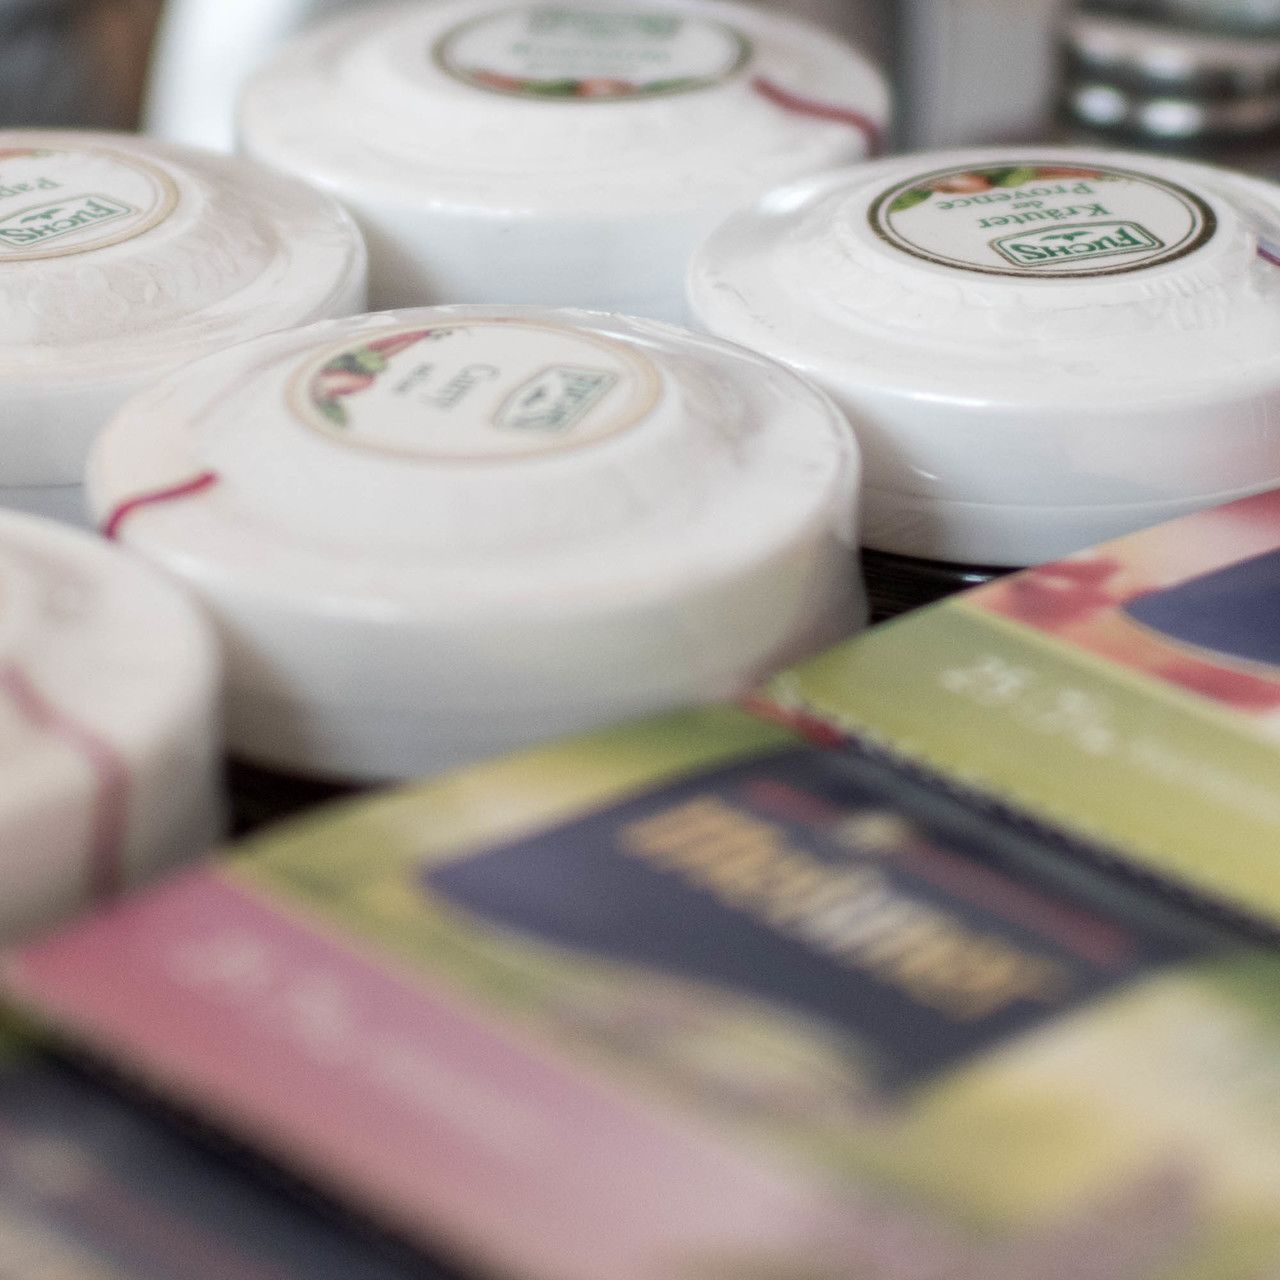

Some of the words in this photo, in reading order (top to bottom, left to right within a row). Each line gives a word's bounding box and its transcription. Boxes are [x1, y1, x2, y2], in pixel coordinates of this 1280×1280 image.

[936, 181, 1095, 210] Provence
[978, 202, 1112, 229] Kräuter
[1011, 227, 1142, 260] FUCHS
